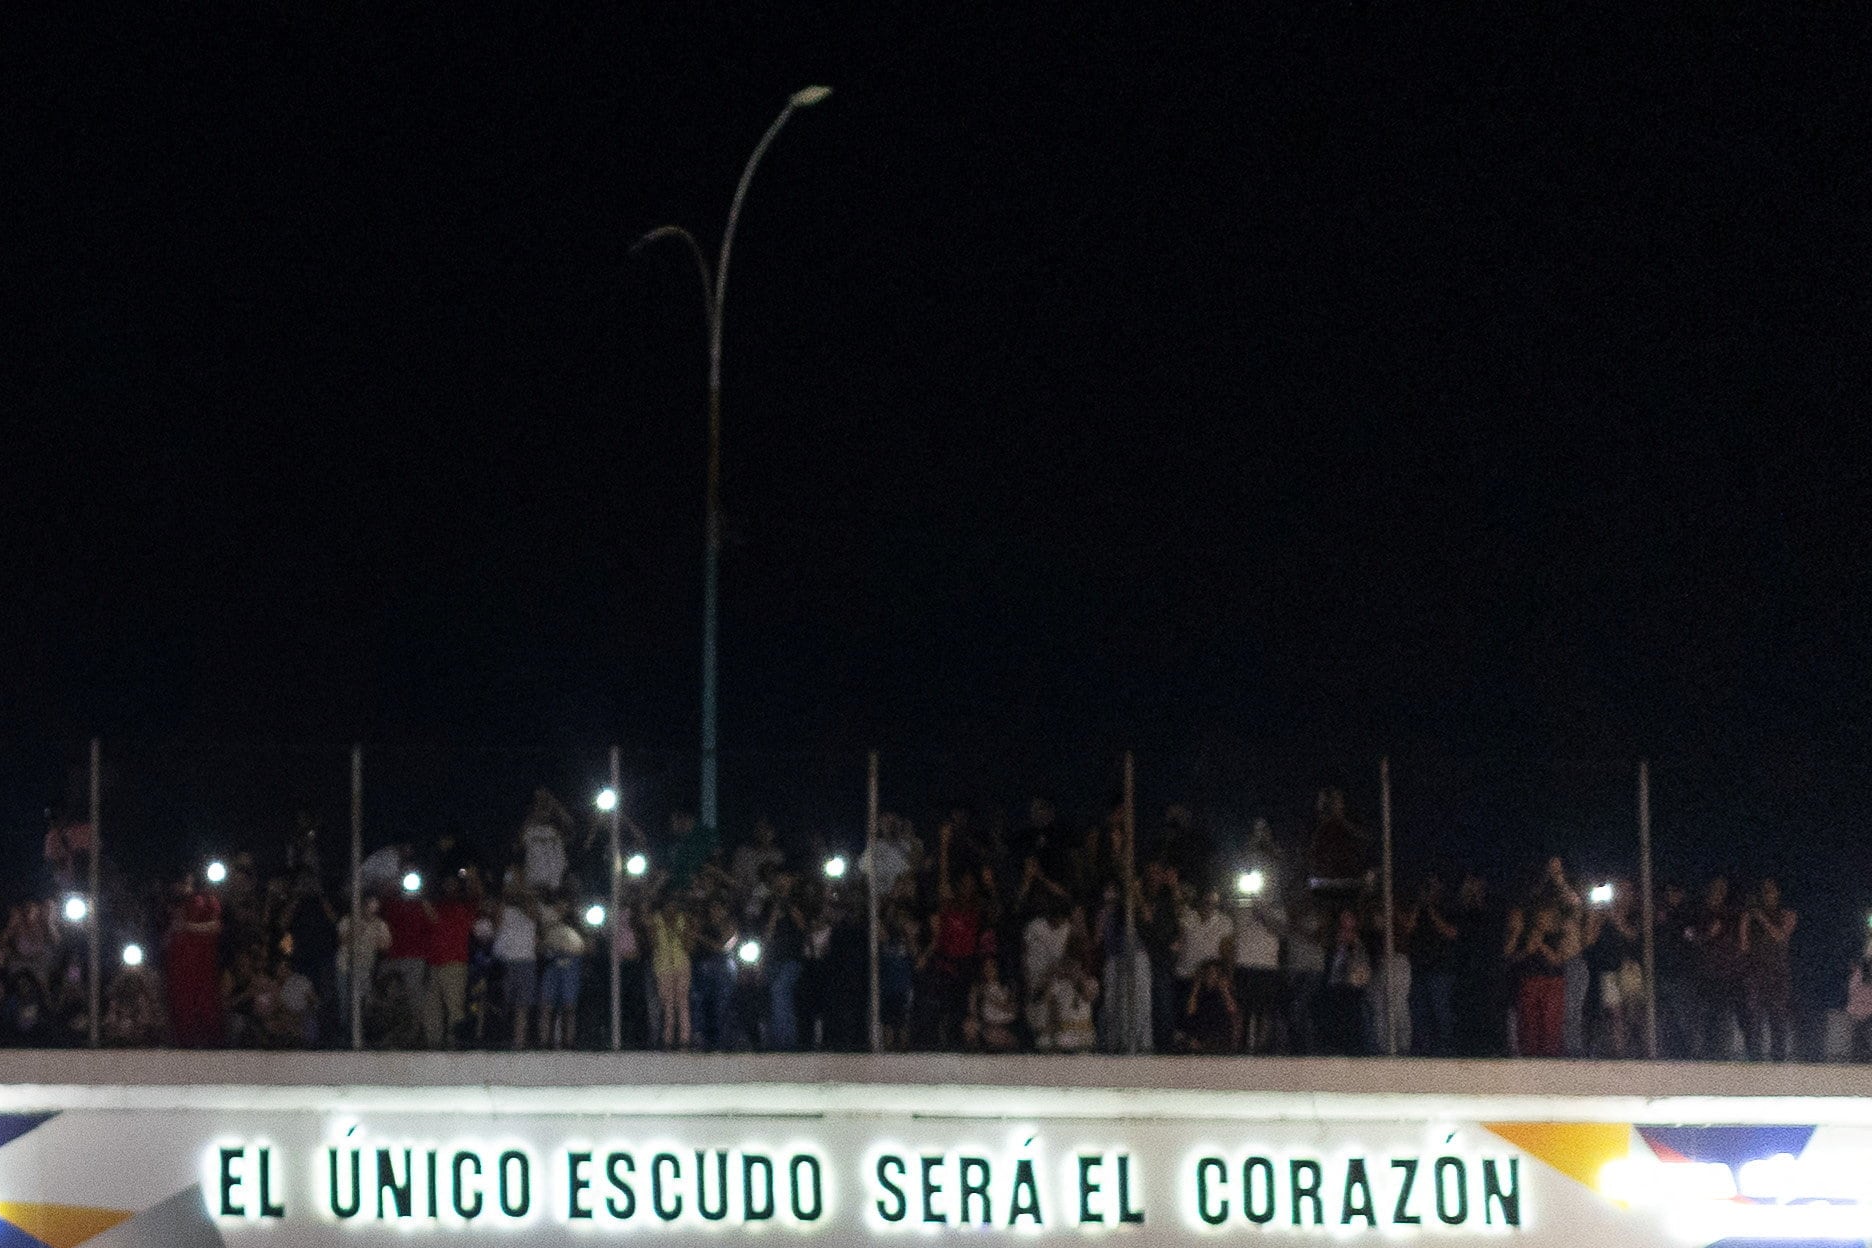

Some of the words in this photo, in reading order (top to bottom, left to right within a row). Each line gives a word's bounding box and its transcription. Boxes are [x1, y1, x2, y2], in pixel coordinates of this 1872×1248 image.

[218, 1147, 284, 1218] EL
[328, 1125, 530, 1219] ÚNICO
[568, 1149, 823, 1221] ESCUDO
[876, 1134, 1044, 1226] SERÁ
[1078, 1155, 1146, 1224] EL
[1196, 1130, 1521, 1228] CORAZÓN
